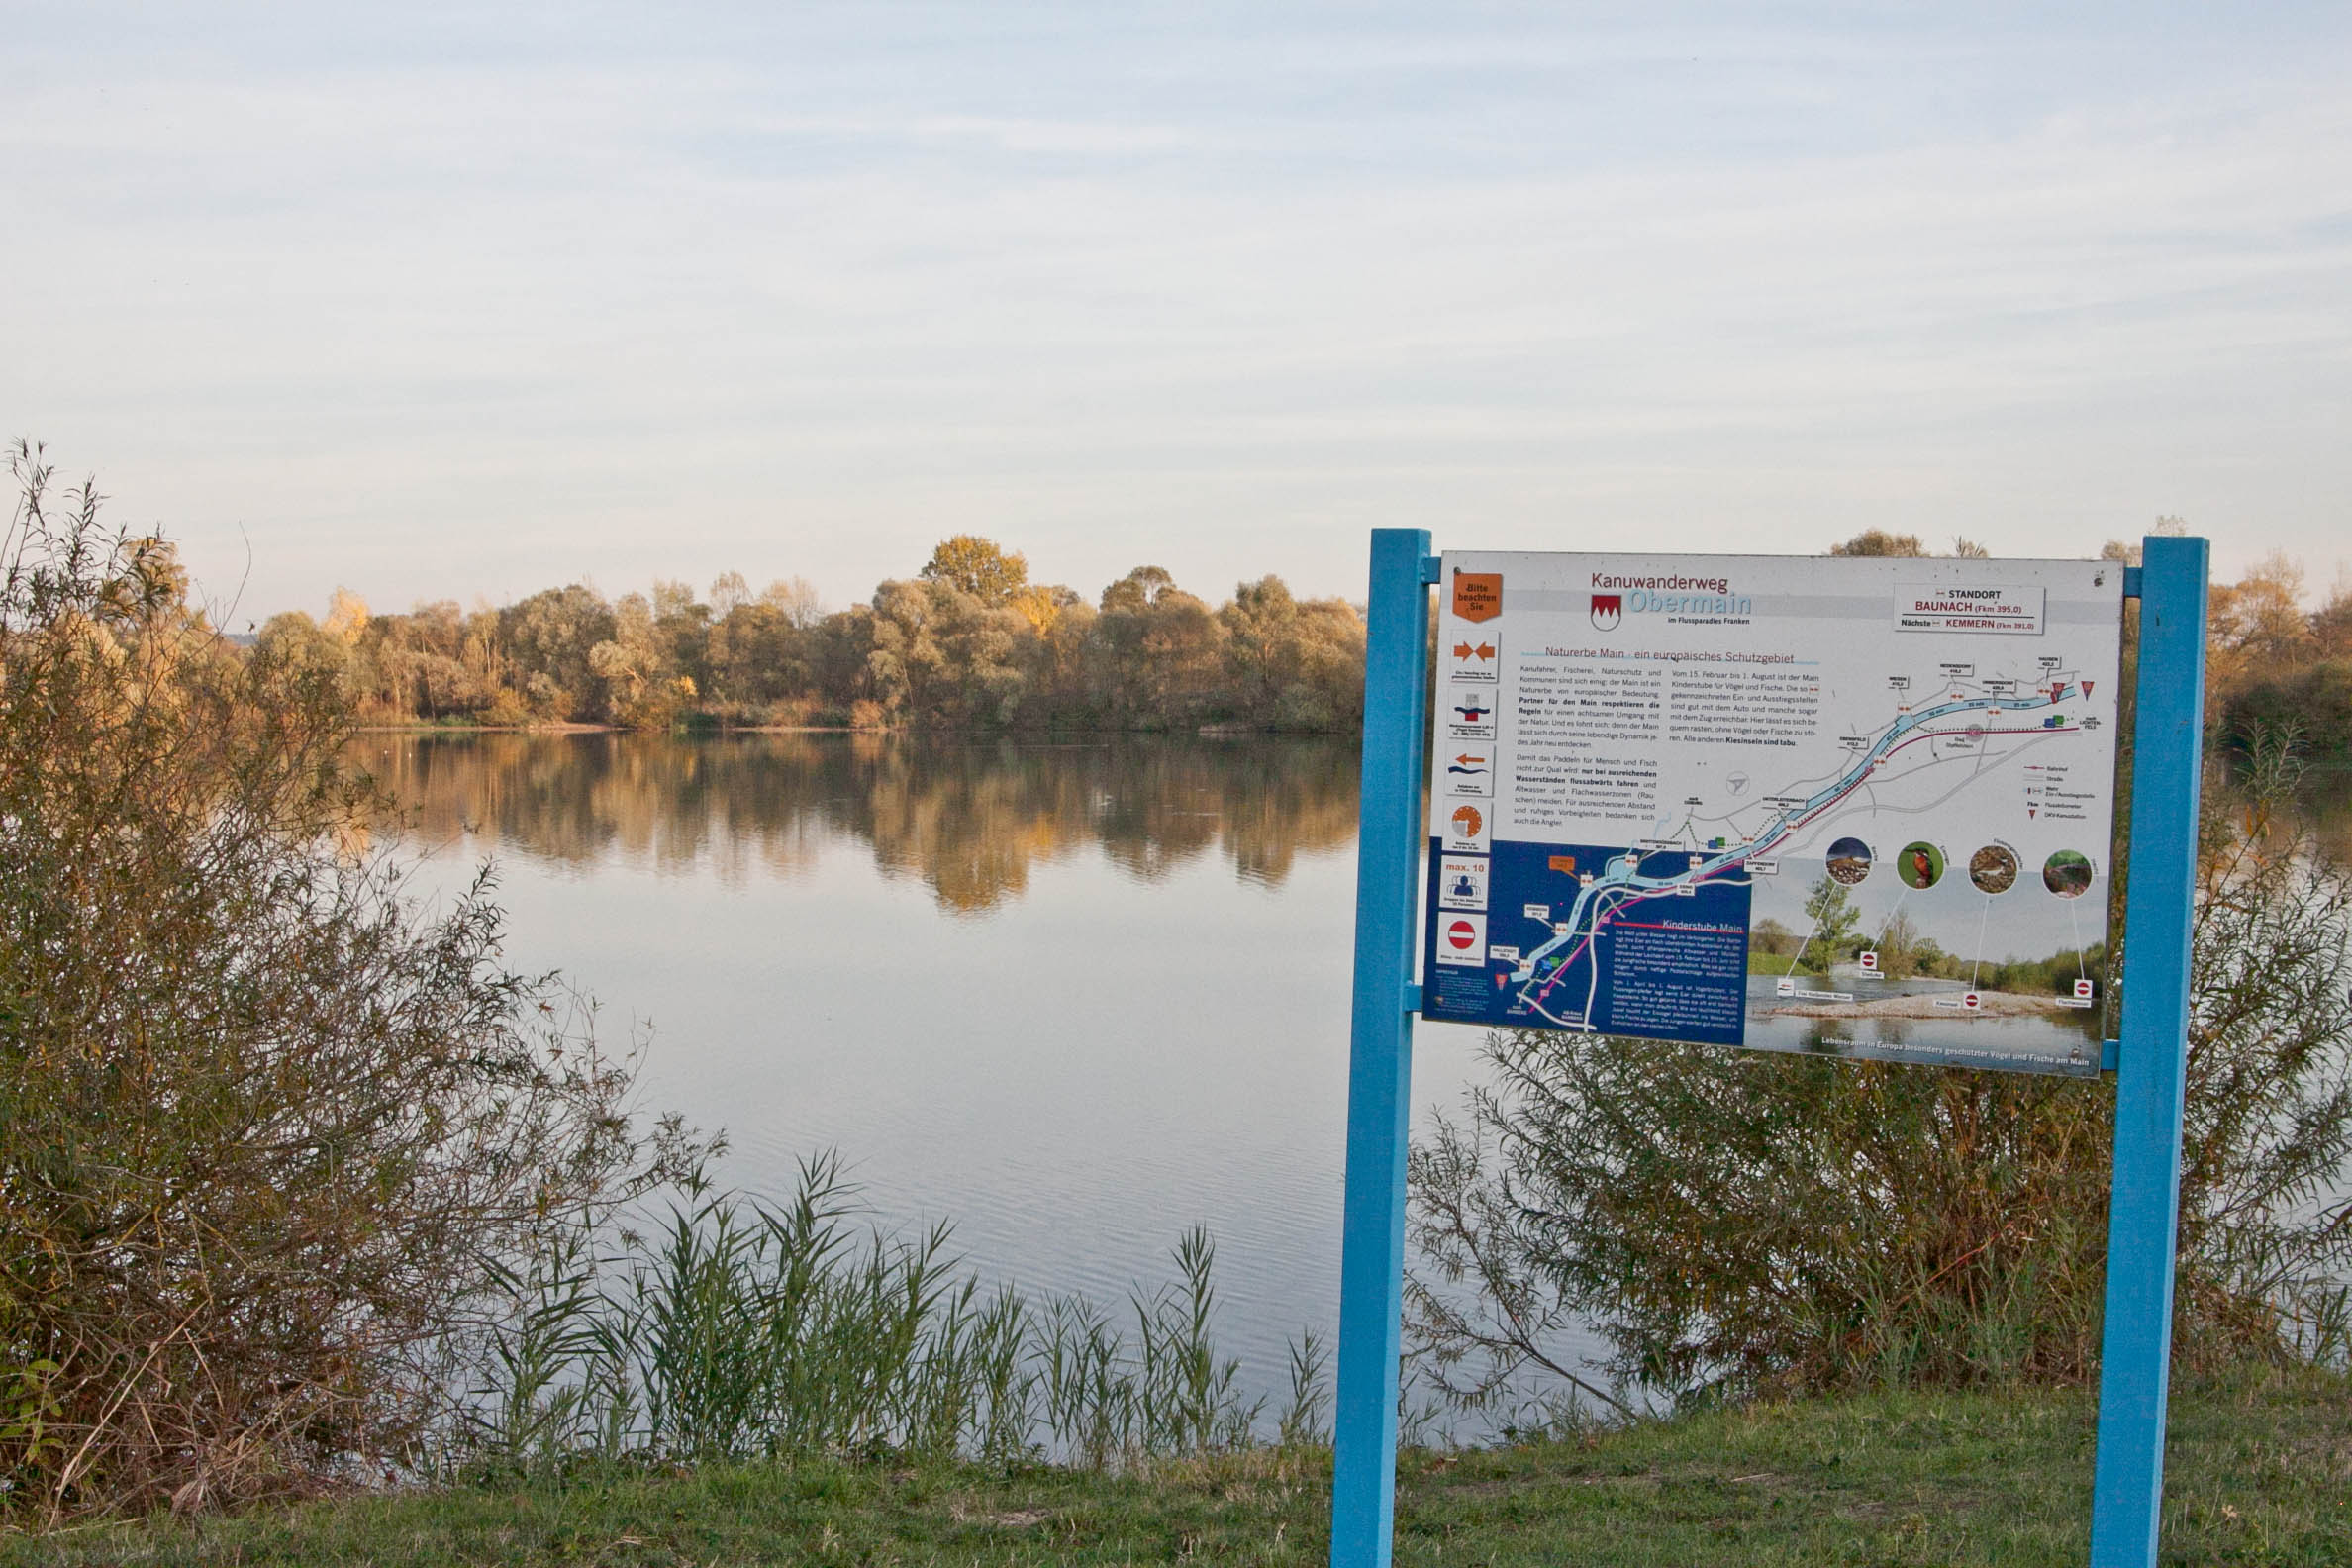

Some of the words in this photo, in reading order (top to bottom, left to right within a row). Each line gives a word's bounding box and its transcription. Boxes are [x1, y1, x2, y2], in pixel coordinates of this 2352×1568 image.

[1592, 573, 1728, 593] Kanuwanderweg
[1466, 584, 1488, 592] Bitte
[1458, 593, 1496, 602] beachten
[1949, 590, 2001, 599] STANDORT
[1470, 602, 1483, 611] Sie
[1629, 590, 1751, 614] Obermain
[1915, 601, 1972, 612] BAUNACH
[1975, 605, 1994, 614] (Fkm
[1997, 606, 2022, 614] 395,0)
[1678, 617, 1722, 626] Flussparadies
[1946, 620, 1994, 628] KEMMERN
[1545, 647, 1596, 658] Naturerbe
[1600, 648, 1624, 658] Main
[1635, 650, 1650, 659] ein
[1726, 652, 1794, 665] Schutzgebiet
[1751, 673, 1775, 681] August
[1671, 691, 1730, 701] gekennzeichneten
[1601, 700, 1644, 708] respektieren
[1617, 711, 1644, 719] Umgang
[1587, 731, 1618, 739] lebendige
[1620, 732, 1648, 740] Dynamik
[1515, 775, 1565, 783] Wasserständen
[1571, 788, 1631, 797] Flachwasserzonen
[1530, 808, 1553, 816] ruhiges
[1558, 809, 1600, 818] Vorbeigleiten
[1663, 919, 1716, 932] Kinderstube
[1720, 923, 1742, 933] Main
[1822, 1037, 1866, 1047] Lebensraum
[1877, 1041, 1902, 1051] Europa
[1905, 1043, 1943, 1054] besonders
[2070, 1058, 2089, 1066] Main
